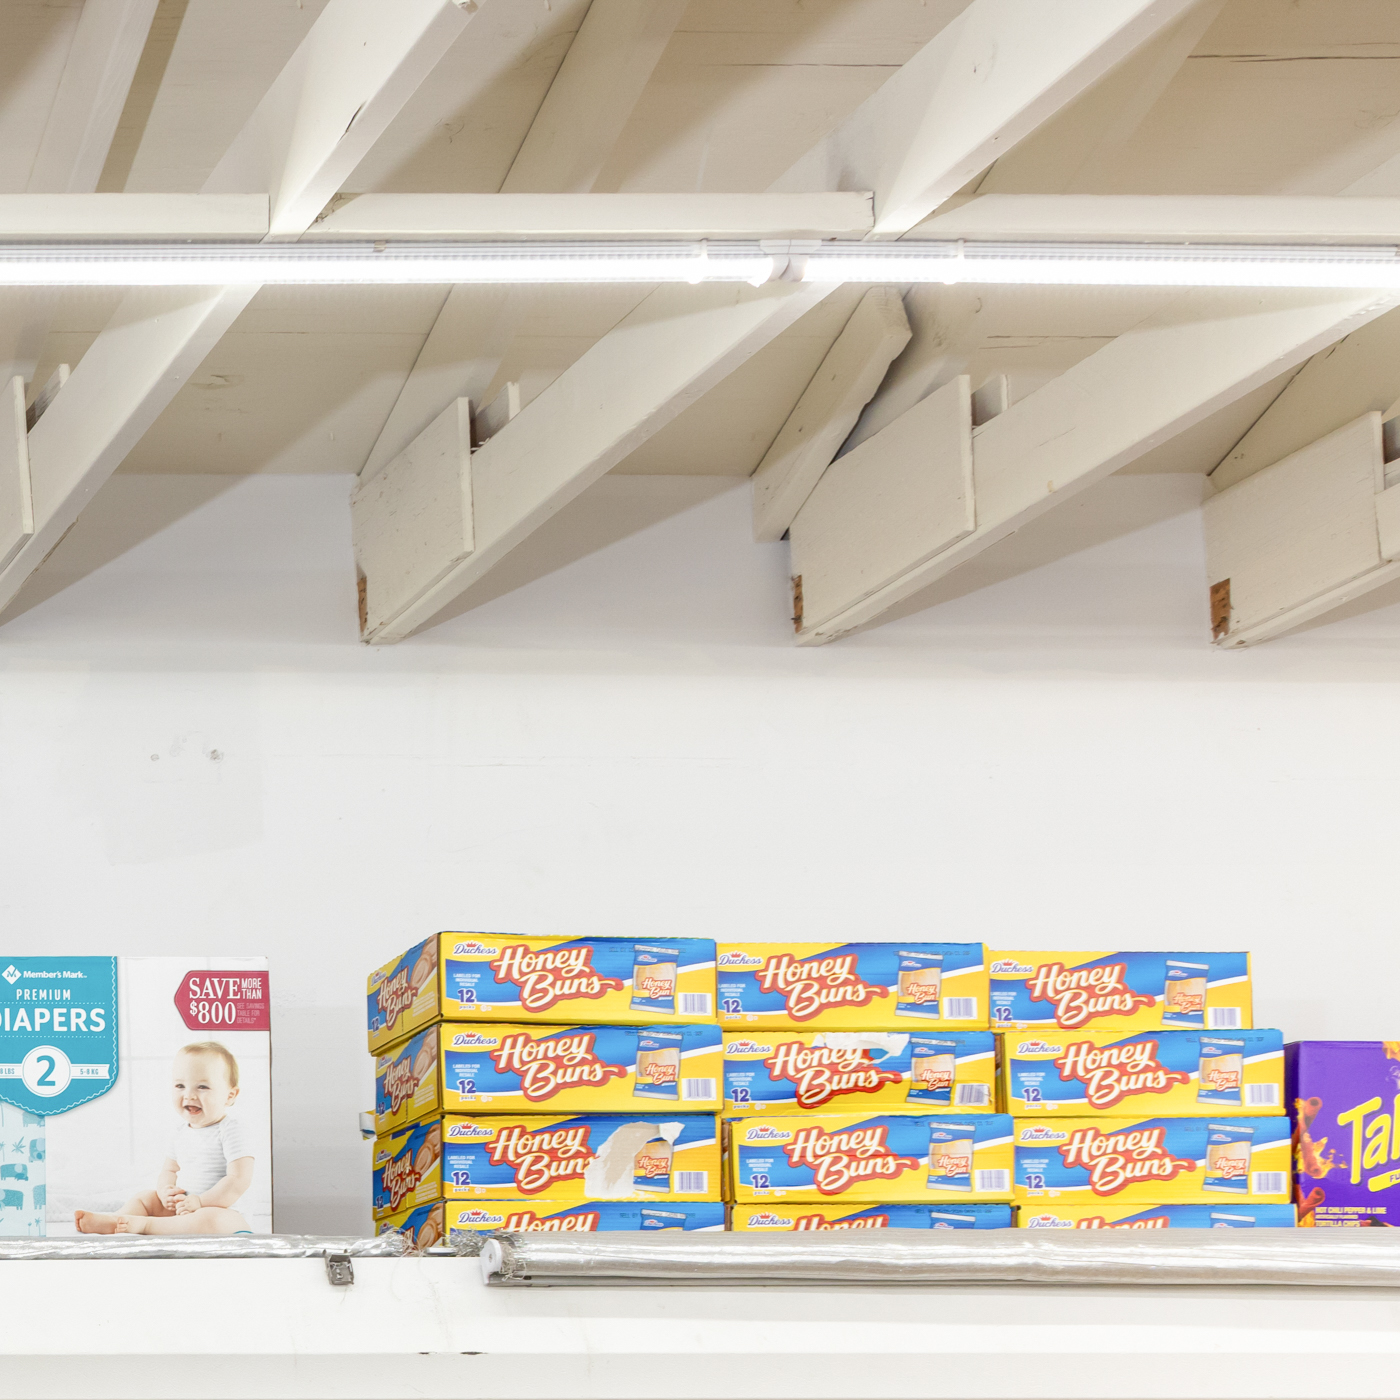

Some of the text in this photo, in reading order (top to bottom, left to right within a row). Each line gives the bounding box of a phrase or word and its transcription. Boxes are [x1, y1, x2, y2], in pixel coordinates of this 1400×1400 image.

[453, 945, 497, 955] Duchess
[493, 947, 588, 980] Honey
[23, 970, 84, 979] Member's Mark
[242, 978, 261, 988] MORE
[759, 955, 854, 989] Honey
[991, 962, 1033, 973] Duchess
[1029, 966, 1124, 998] Honey
[17, 989, 71, 1000] PREMIUM
[189, 978, 240, 999] SAVE
[242, 988, 262, 999] THAN
[522, 972, 616, 1008] Buns
[784, 982, 881, 1016] Buns
[189, 1001, 236, 1024] $800
[1055, 991, 1148, 1024] Buns
[493, 1036, 590, 1068] Honey
[767, 1043, 867, 1075] Honey
[1058, 1043, 1155, 1076] Honey
[36, 1056, 56, 1086] 2
[525, 1062, 618, 1096] Buns
[793, 1069, 894, 1103] Buns
[1084, 1069, 1181, 1104] Buns
[489, 1128, 586, 1160] Honey
[788, 1128, 885, 1161] Honey
[1063, 1130, 1162, 1163] Honey
[814, 1154, 910, 1189] Buns
[1089, 1157, 1189, 1191] Buns
